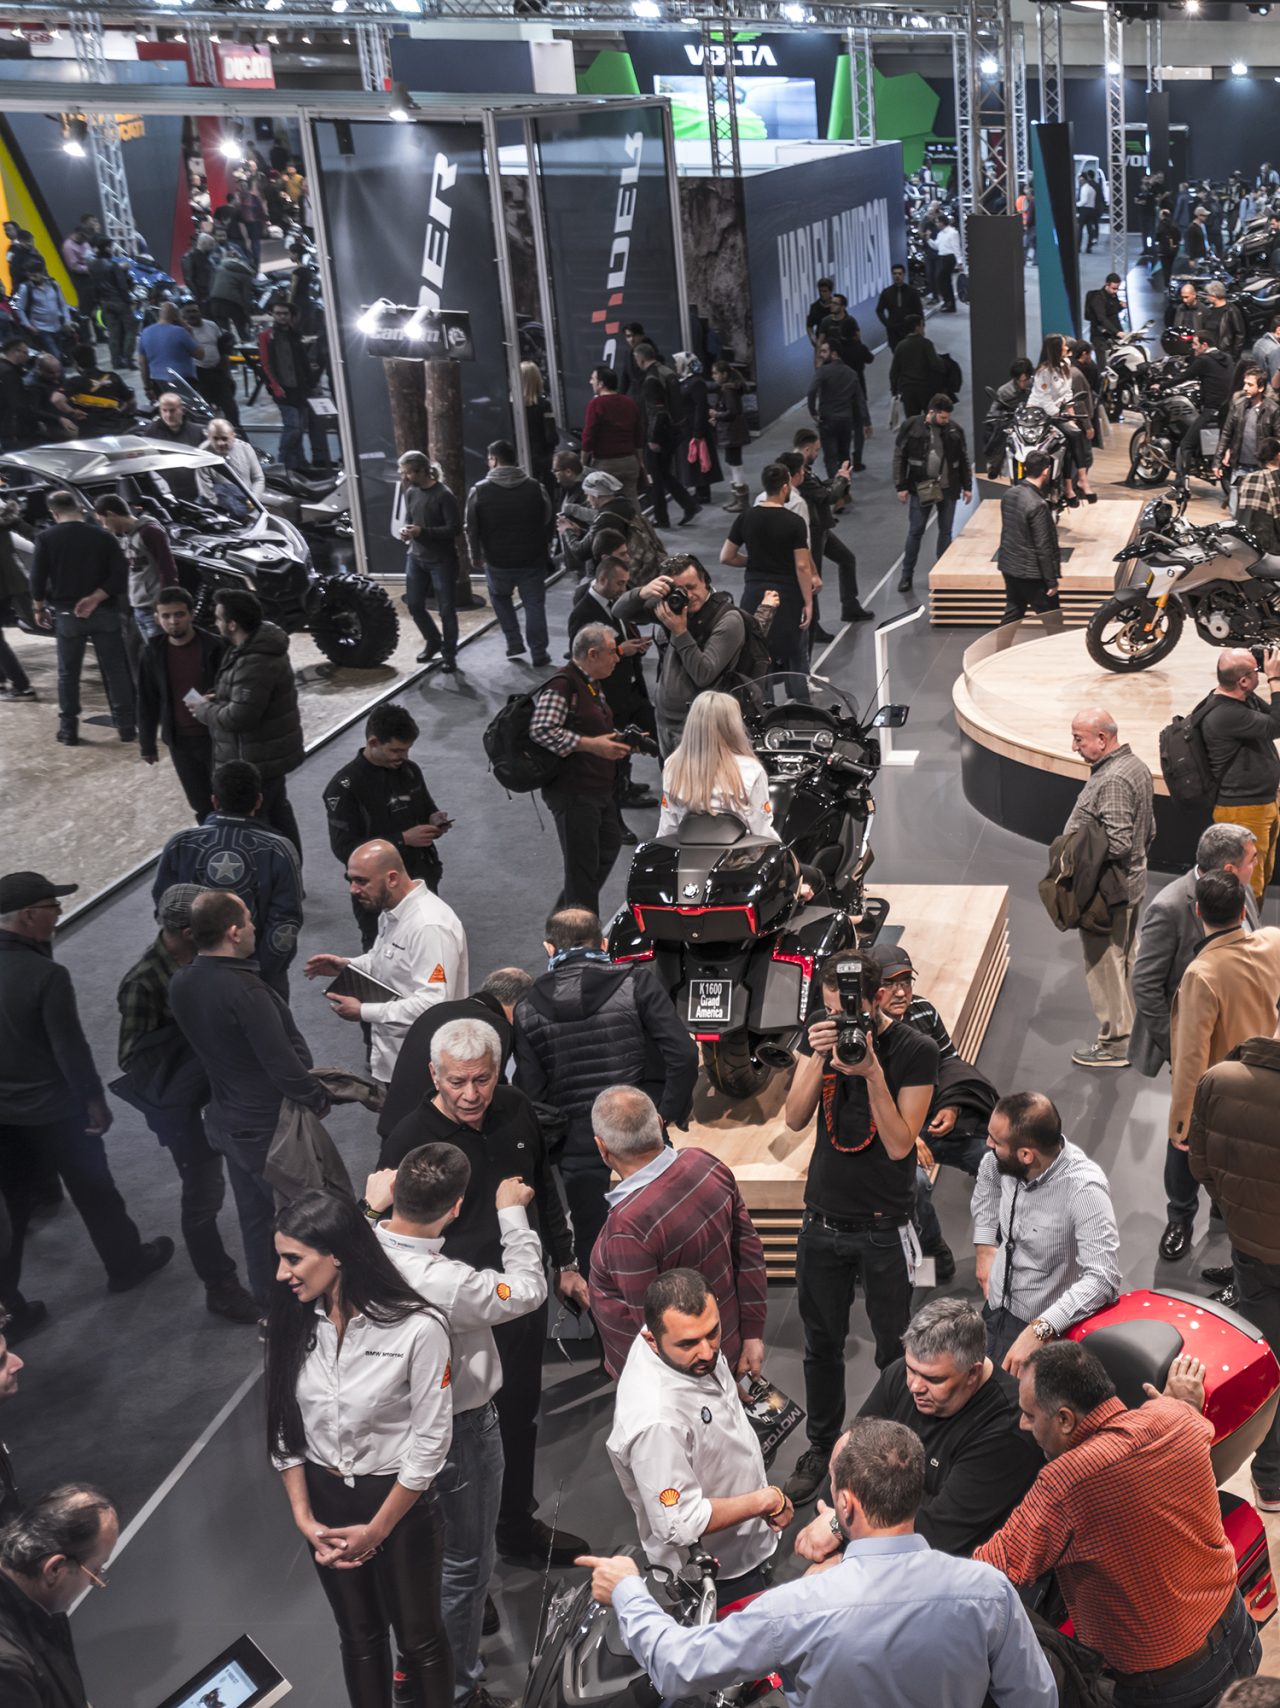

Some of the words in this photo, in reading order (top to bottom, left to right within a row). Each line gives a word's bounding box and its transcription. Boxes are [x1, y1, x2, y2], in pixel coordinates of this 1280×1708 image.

[684, 44, 778, 66] VOLTA
[223, 56, 273, 80] DUCATI
[777, 197, 894, 347] HARLEY-DAVIDSON
[695, 1005, 724, 1018] America
[700, 995, 721, 1007] Grand
